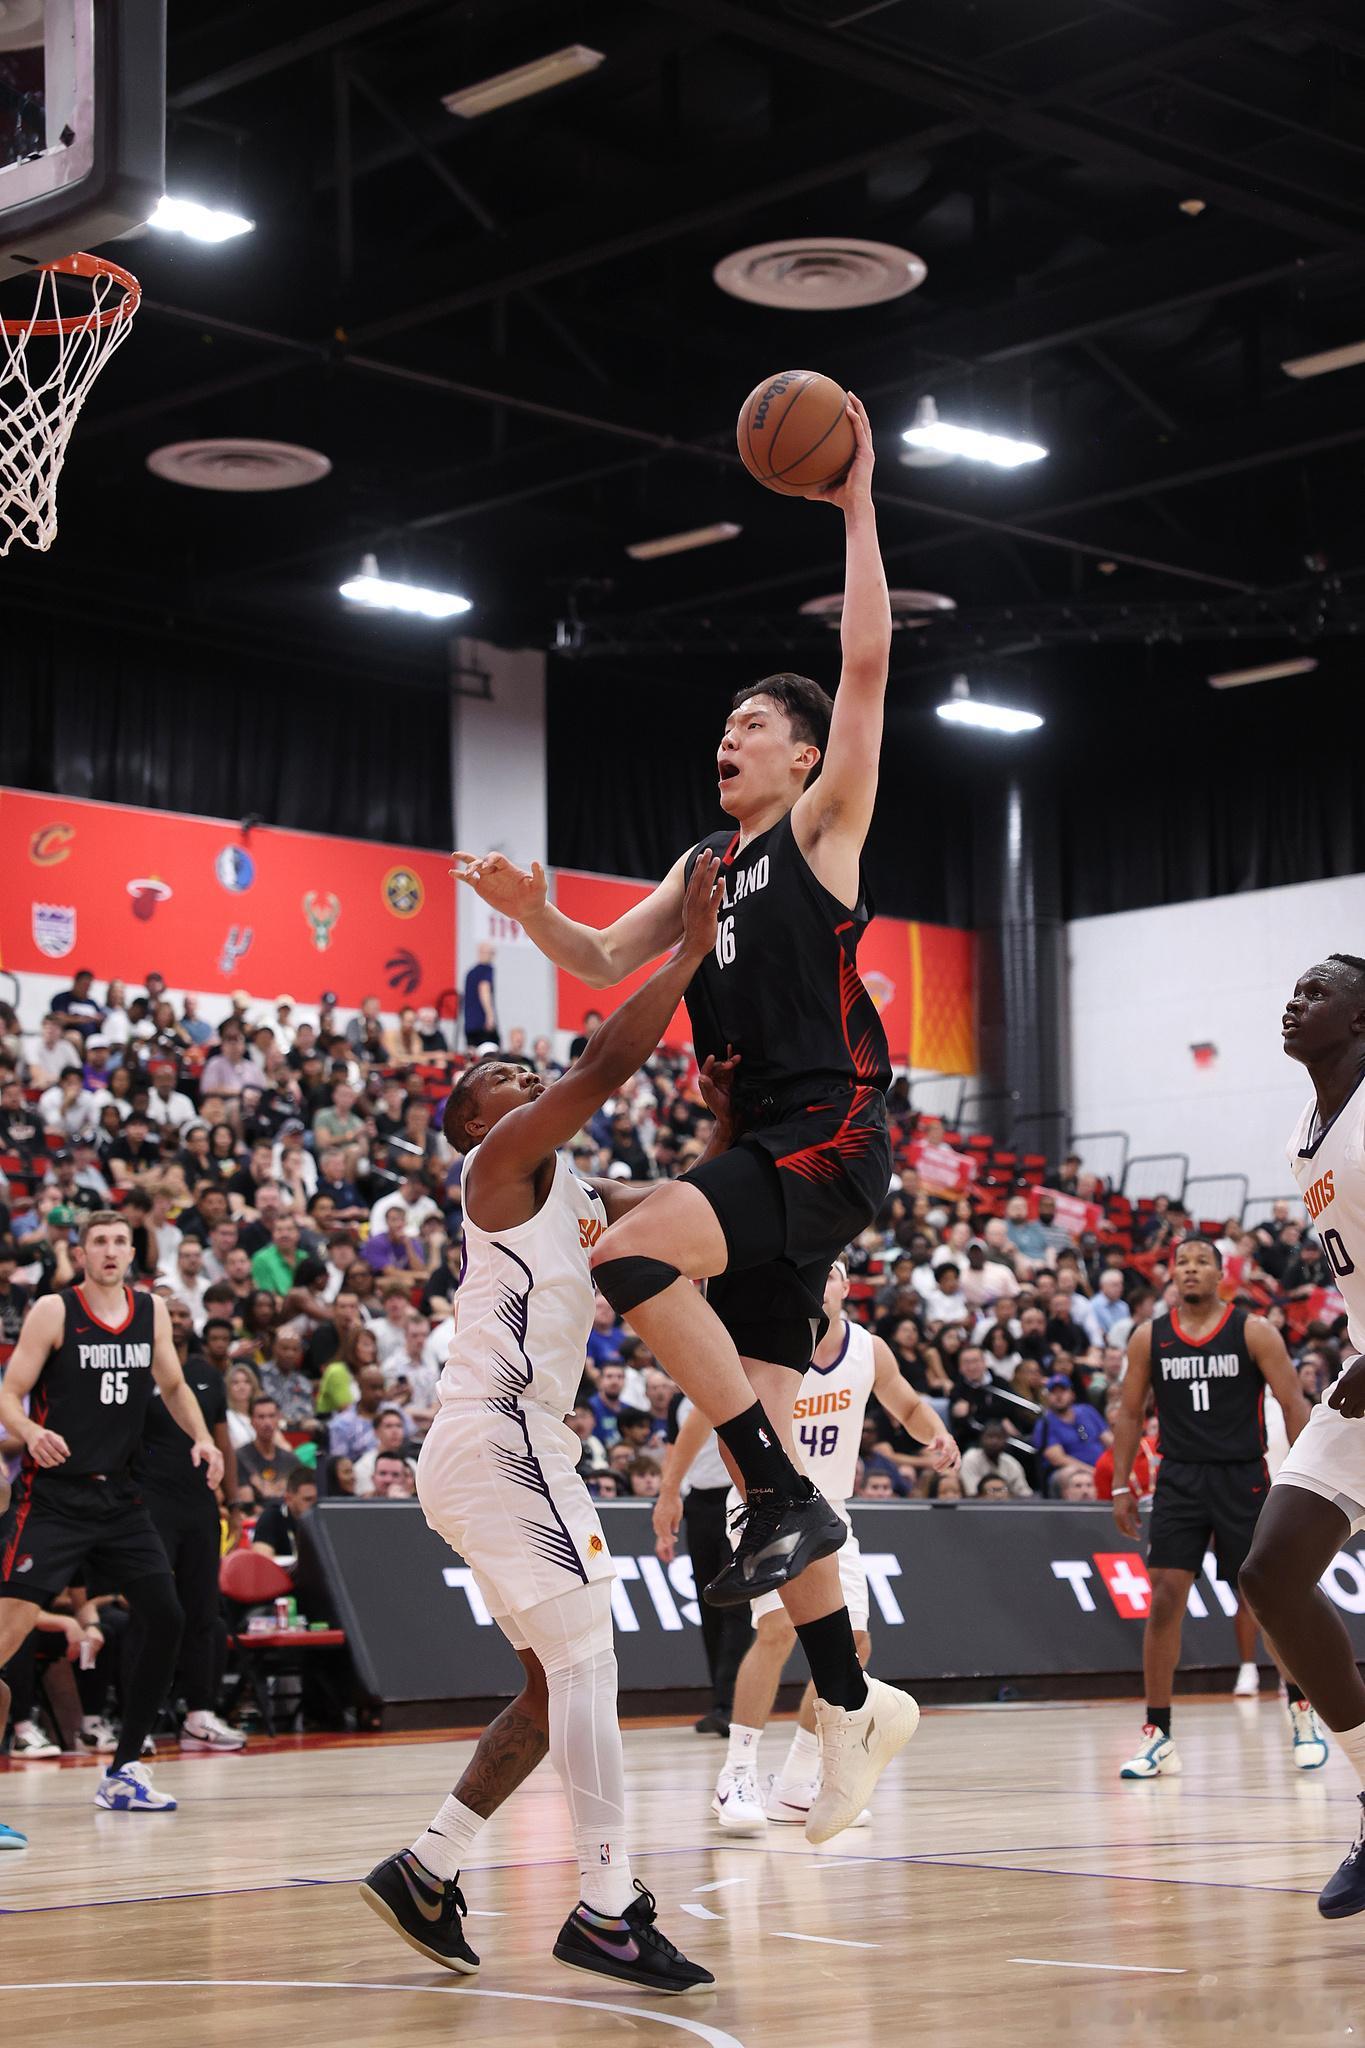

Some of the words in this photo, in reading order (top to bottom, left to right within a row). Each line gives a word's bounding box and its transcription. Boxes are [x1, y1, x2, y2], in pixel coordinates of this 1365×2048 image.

[78, 1342, 151, 1369] PORTLAND
[1160, 1353, 1239, 1381] PORTLAND
[100, 1371, 129, 1405] 65
[793, 1388, 852, 1420] SUNS
[1189, 1380, 1210, 1412] 11
[800, 1425, 839, 1457] 48
